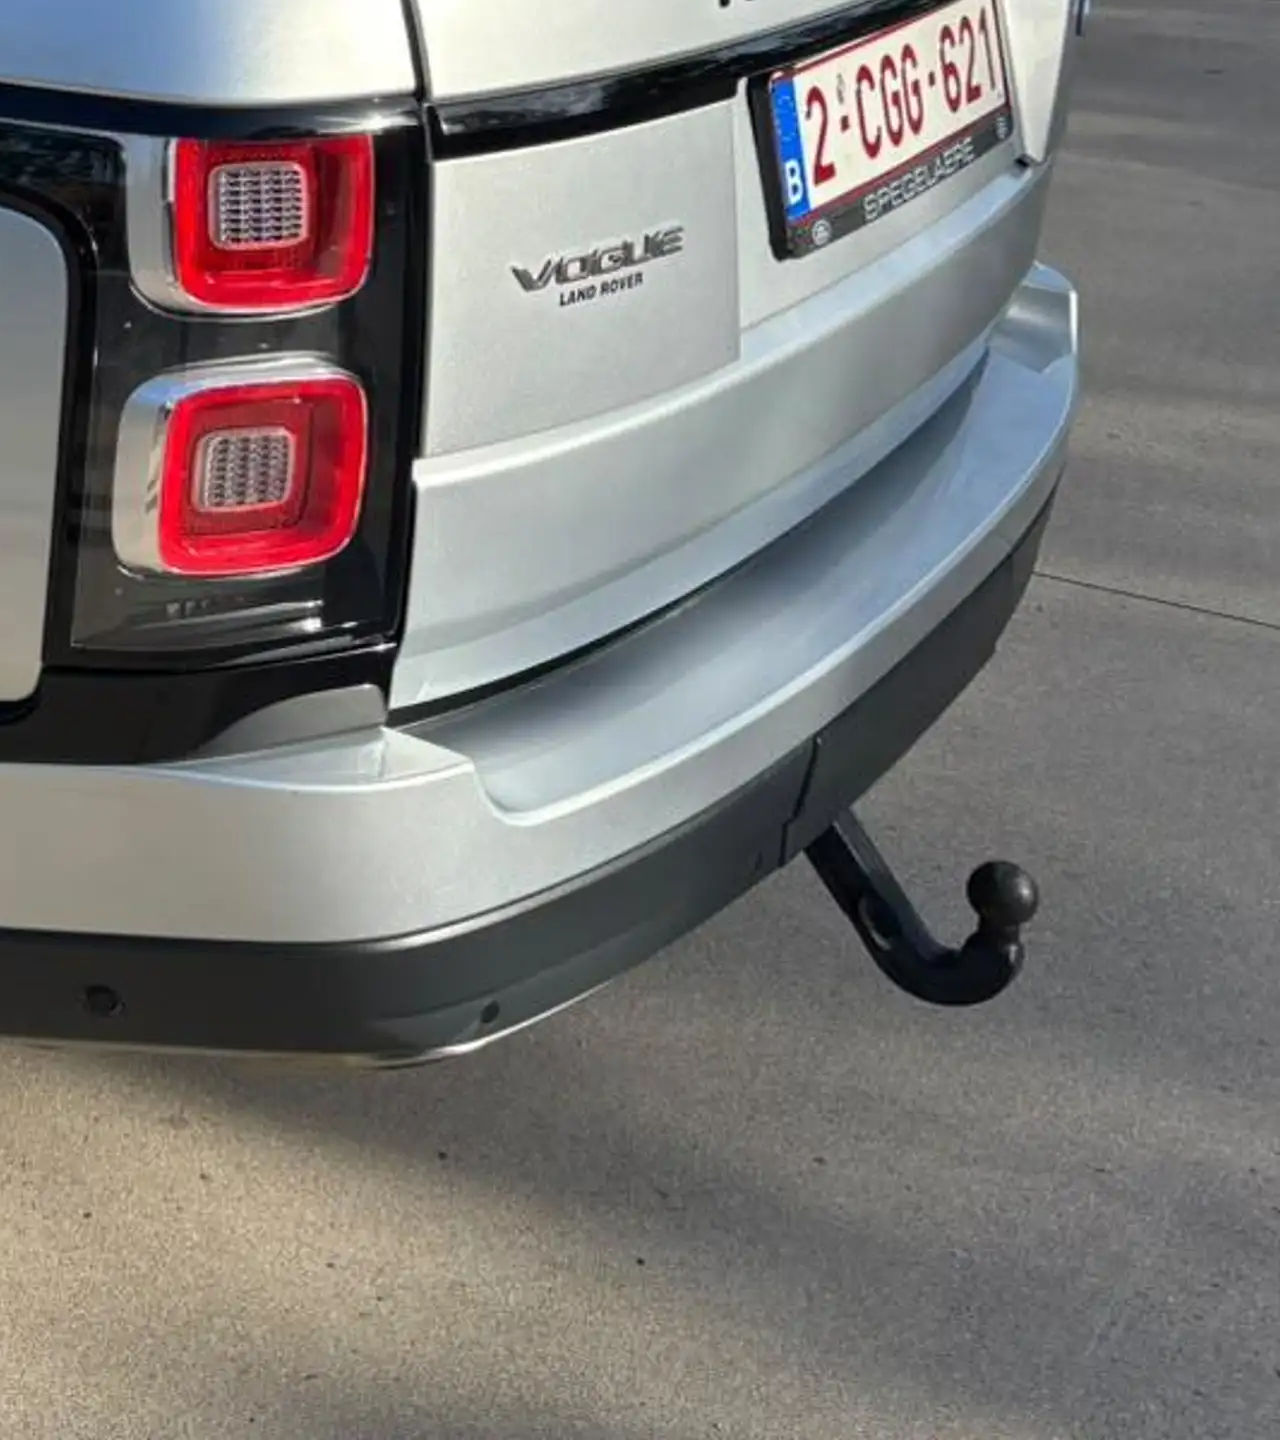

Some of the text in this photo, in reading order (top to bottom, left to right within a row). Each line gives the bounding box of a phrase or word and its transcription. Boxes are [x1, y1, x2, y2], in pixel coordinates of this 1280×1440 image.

[785, 158, 804, 205] B
[510, 224, 685, 293] VOGUE
[559, 271, 644, 307] LAND ROVER
